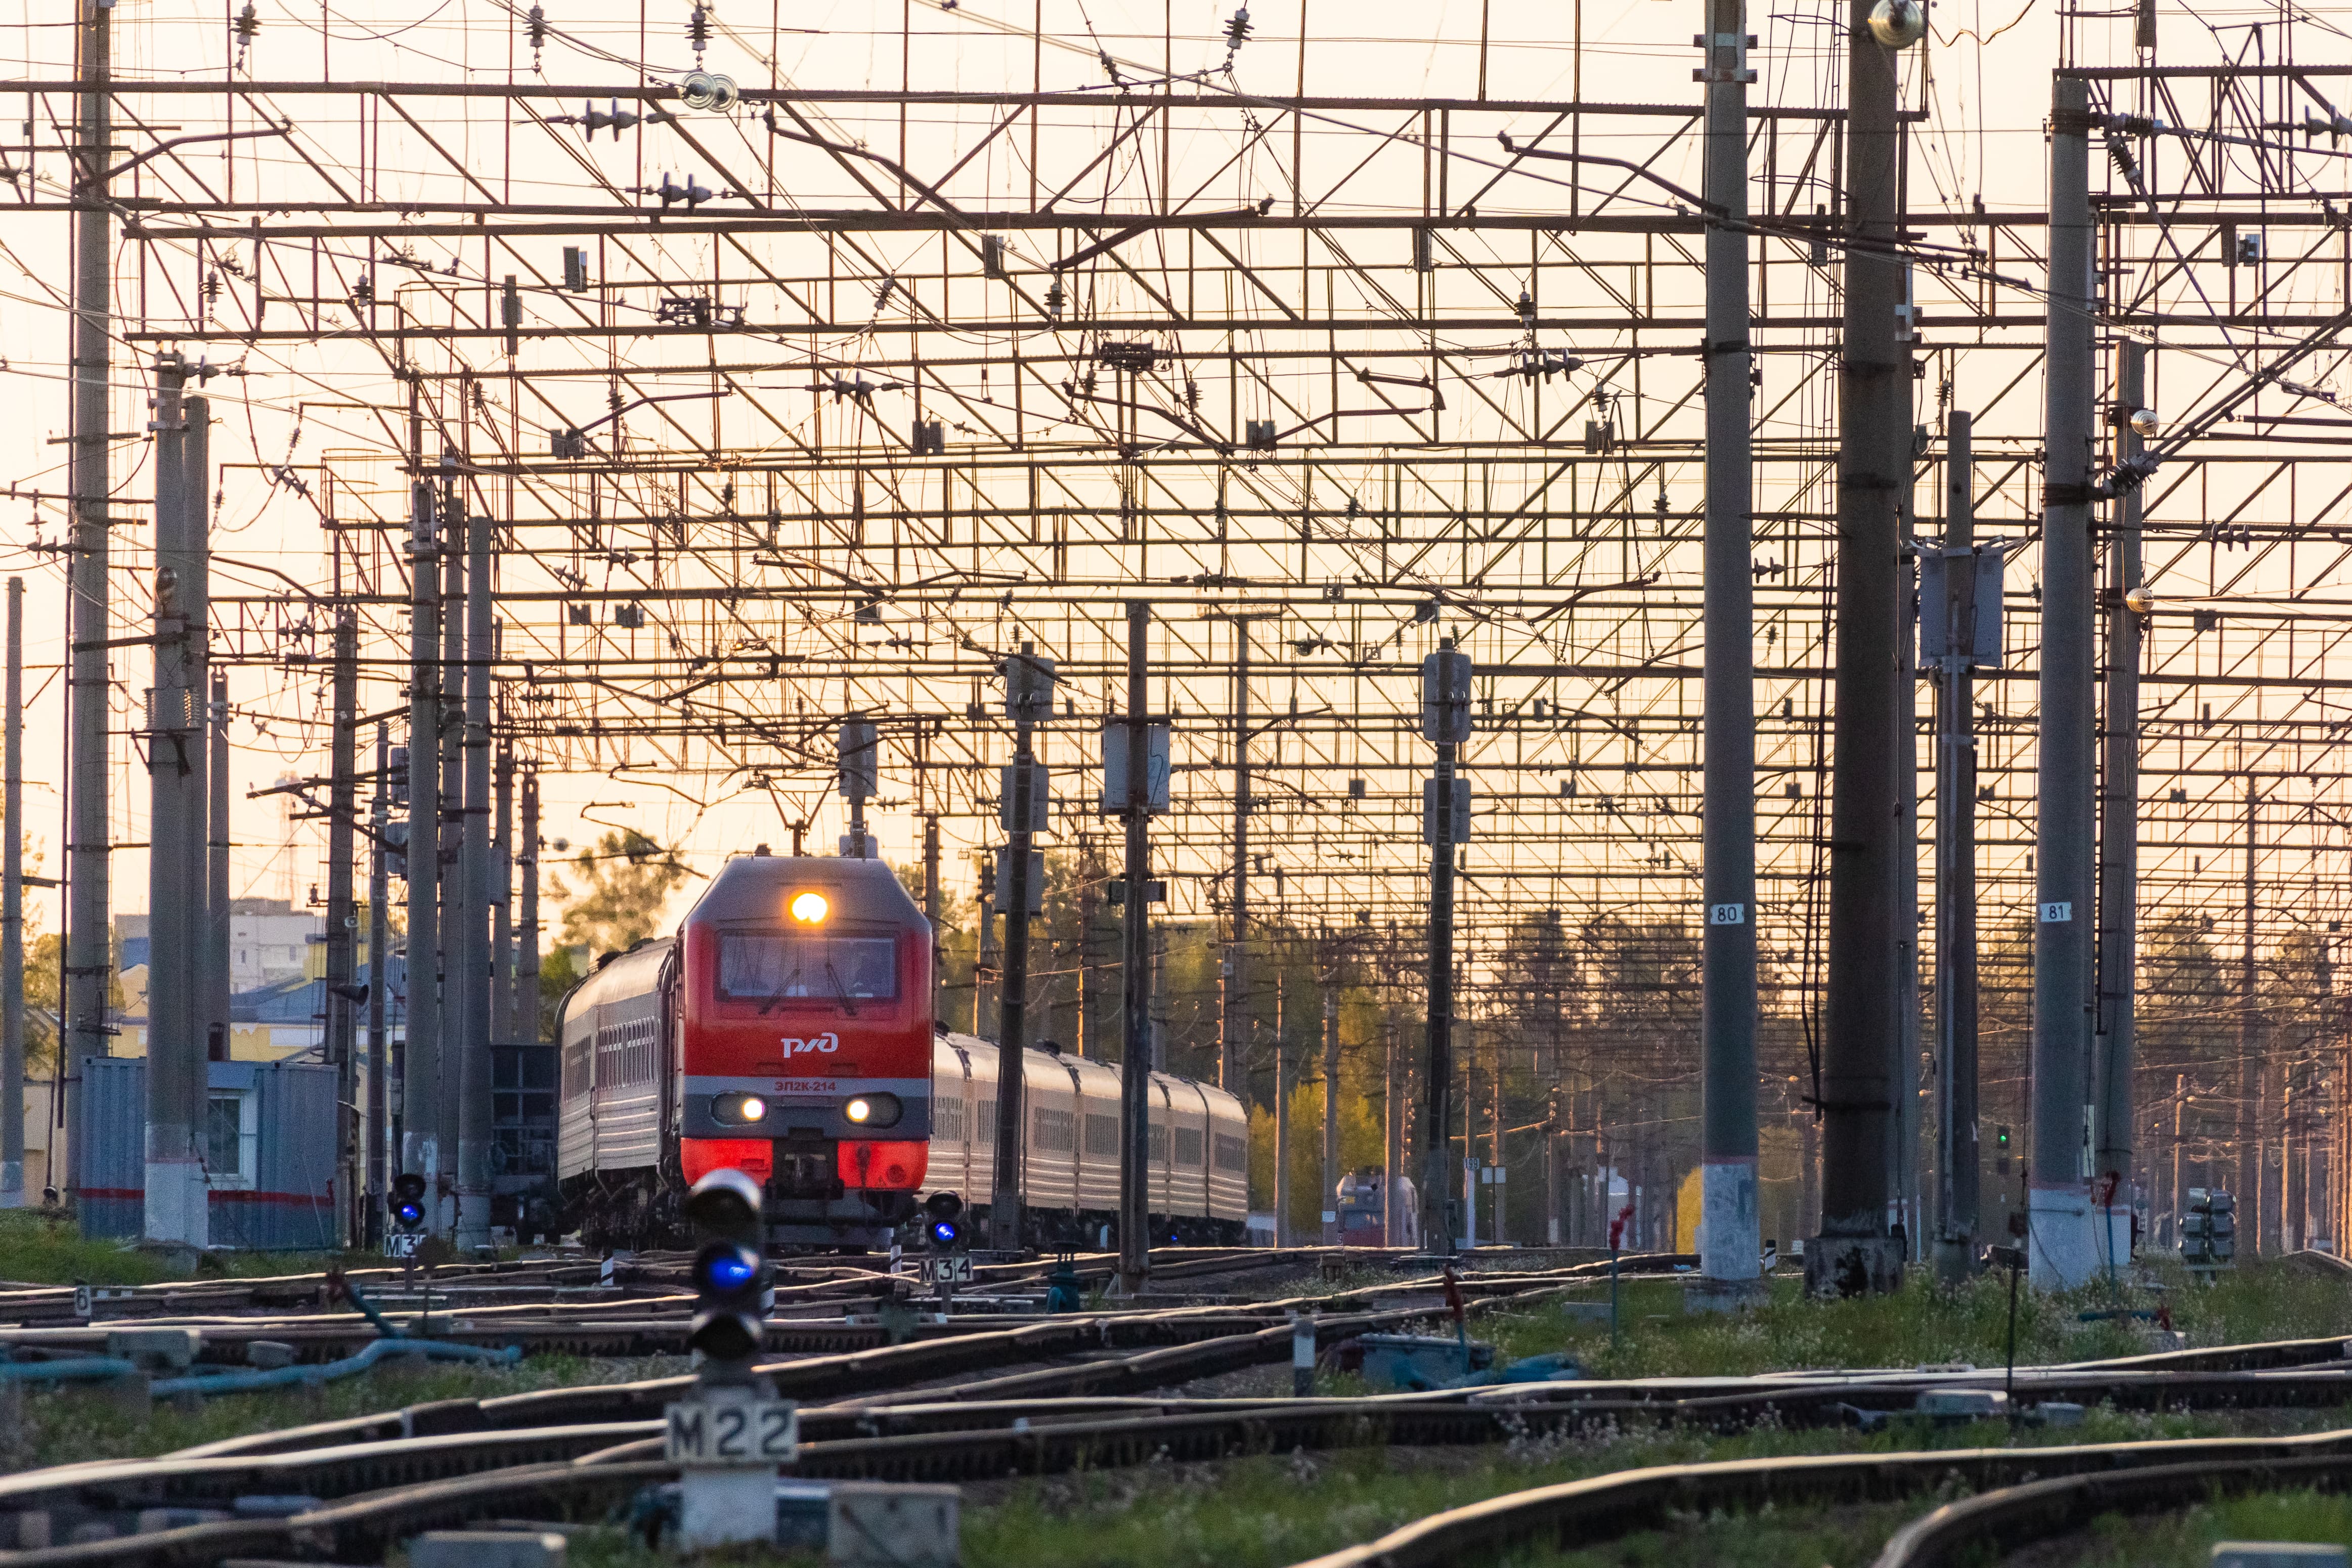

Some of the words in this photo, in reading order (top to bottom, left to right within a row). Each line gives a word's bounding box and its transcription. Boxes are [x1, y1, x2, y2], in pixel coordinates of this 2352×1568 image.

[1718, 906, 1737, 922] 80
[2049, 905, 2064, 919] 81
[775, 1081, 836, 1092] ЭП2К-214
[385, 1235, 421, 1255] М3
[920, 1258, 971, 1281] М34
[673, 1408, 791, 1458] М22
